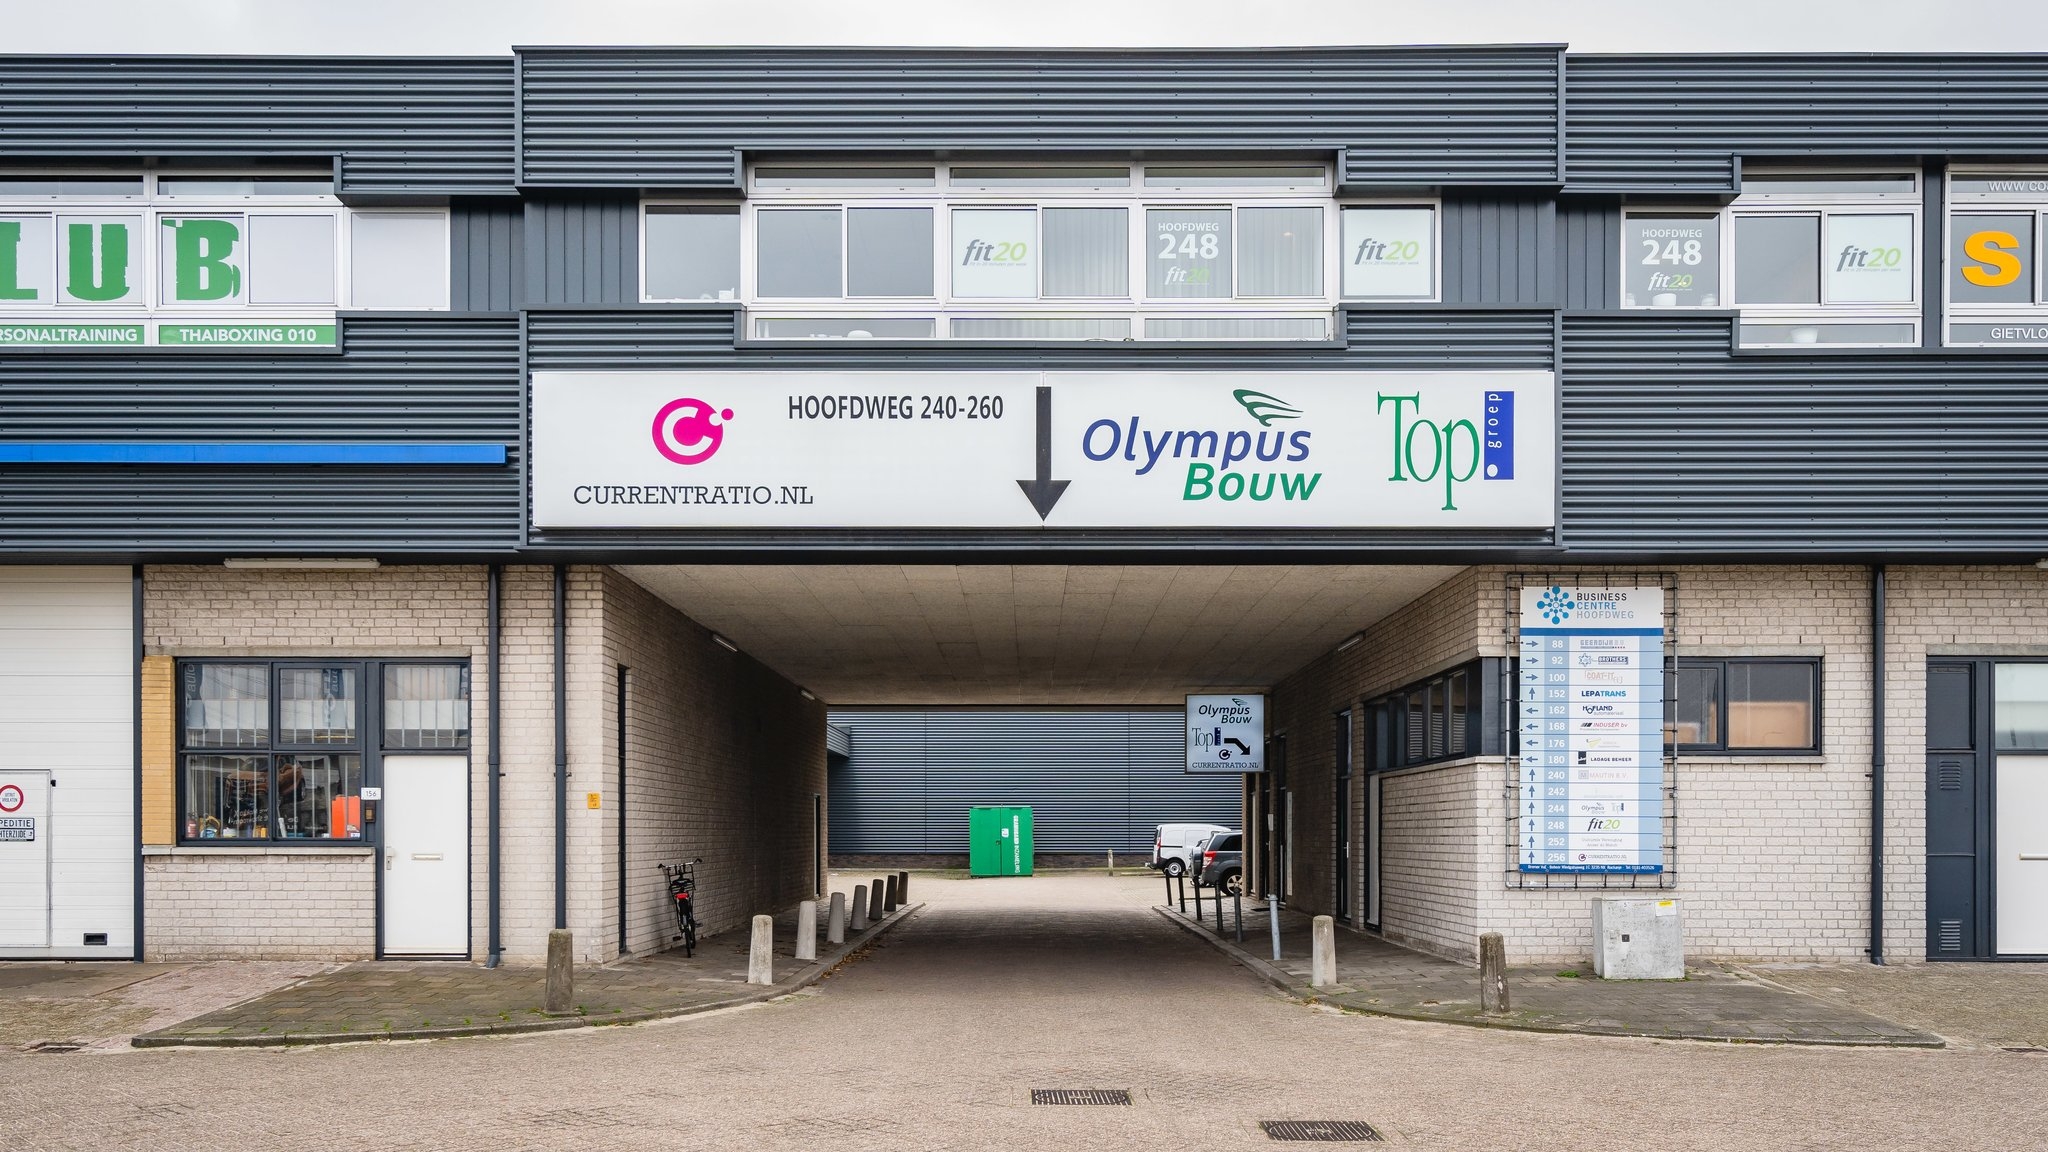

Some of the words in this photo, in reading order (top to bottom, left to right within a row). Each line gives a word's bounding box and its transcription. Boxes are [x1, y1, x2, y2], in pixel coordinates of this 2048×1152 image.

[2029, 181, 2048, 191] CO
[1158, 222, 1219, 232] HOOFDWEG
[1641, 229, 1702, 238] HOOFDWEG
[1158, 233, 1219, 259] 248
[962, 239, 1027, 265] fit20
[1354, 238, 1419, 265] fit20
[1641, 240, 1702, 265] 248
[1836, 245, 1901, 272] fit20
[1960, 230, 2022, 287] S
[1165, 266, 1210, 285] fit20
[1647, 272, 1693, 291] fit20
[180, 328, 283, 341] THAIBOXING
[288, 328, 317, 341] 010
[788, 395, 913, 420] HOOFDWEG
[920, 395, 1004, 420] 240-260
[1488, 393, 1503, 448] groep
[1082, 416, 1311, 476] Olympus
[1377, 391, 1480, 511] Top
[573, 485, 814, 506] CURRENTRATIO.NL
[1577, 592, 1627, 601] BUSINESS
[1577, 601, 1617, 610] CENTRE
[1577, 610, 1634, 619] HOOFDWEG
[1551, 640, 1563, 648] 88
[1551, 657, 1563, 665] 92
[1549, 674, 1565, 682] 100
[1198, 704, 1250, 718] Olympus
[1548, 706, 1565, 714] 162
[1548, 722, 1565, 730] 168
[1192, 727, 1214, 752] Top
[1548, 740, 1565, 748] 176
[1548, 756, 1565, 764] 180
[1548, 771, 1565, 779] 240
[1548, 788, 1565, 796] 242
[1548, 805, 1565, 813] 244
[1548, 822, 1565, 830] 248
[1587, 818, 1620, 831] fit20
[1548, 838, 1565, 846] 252
[1548, 854, 1565, 862] 256
